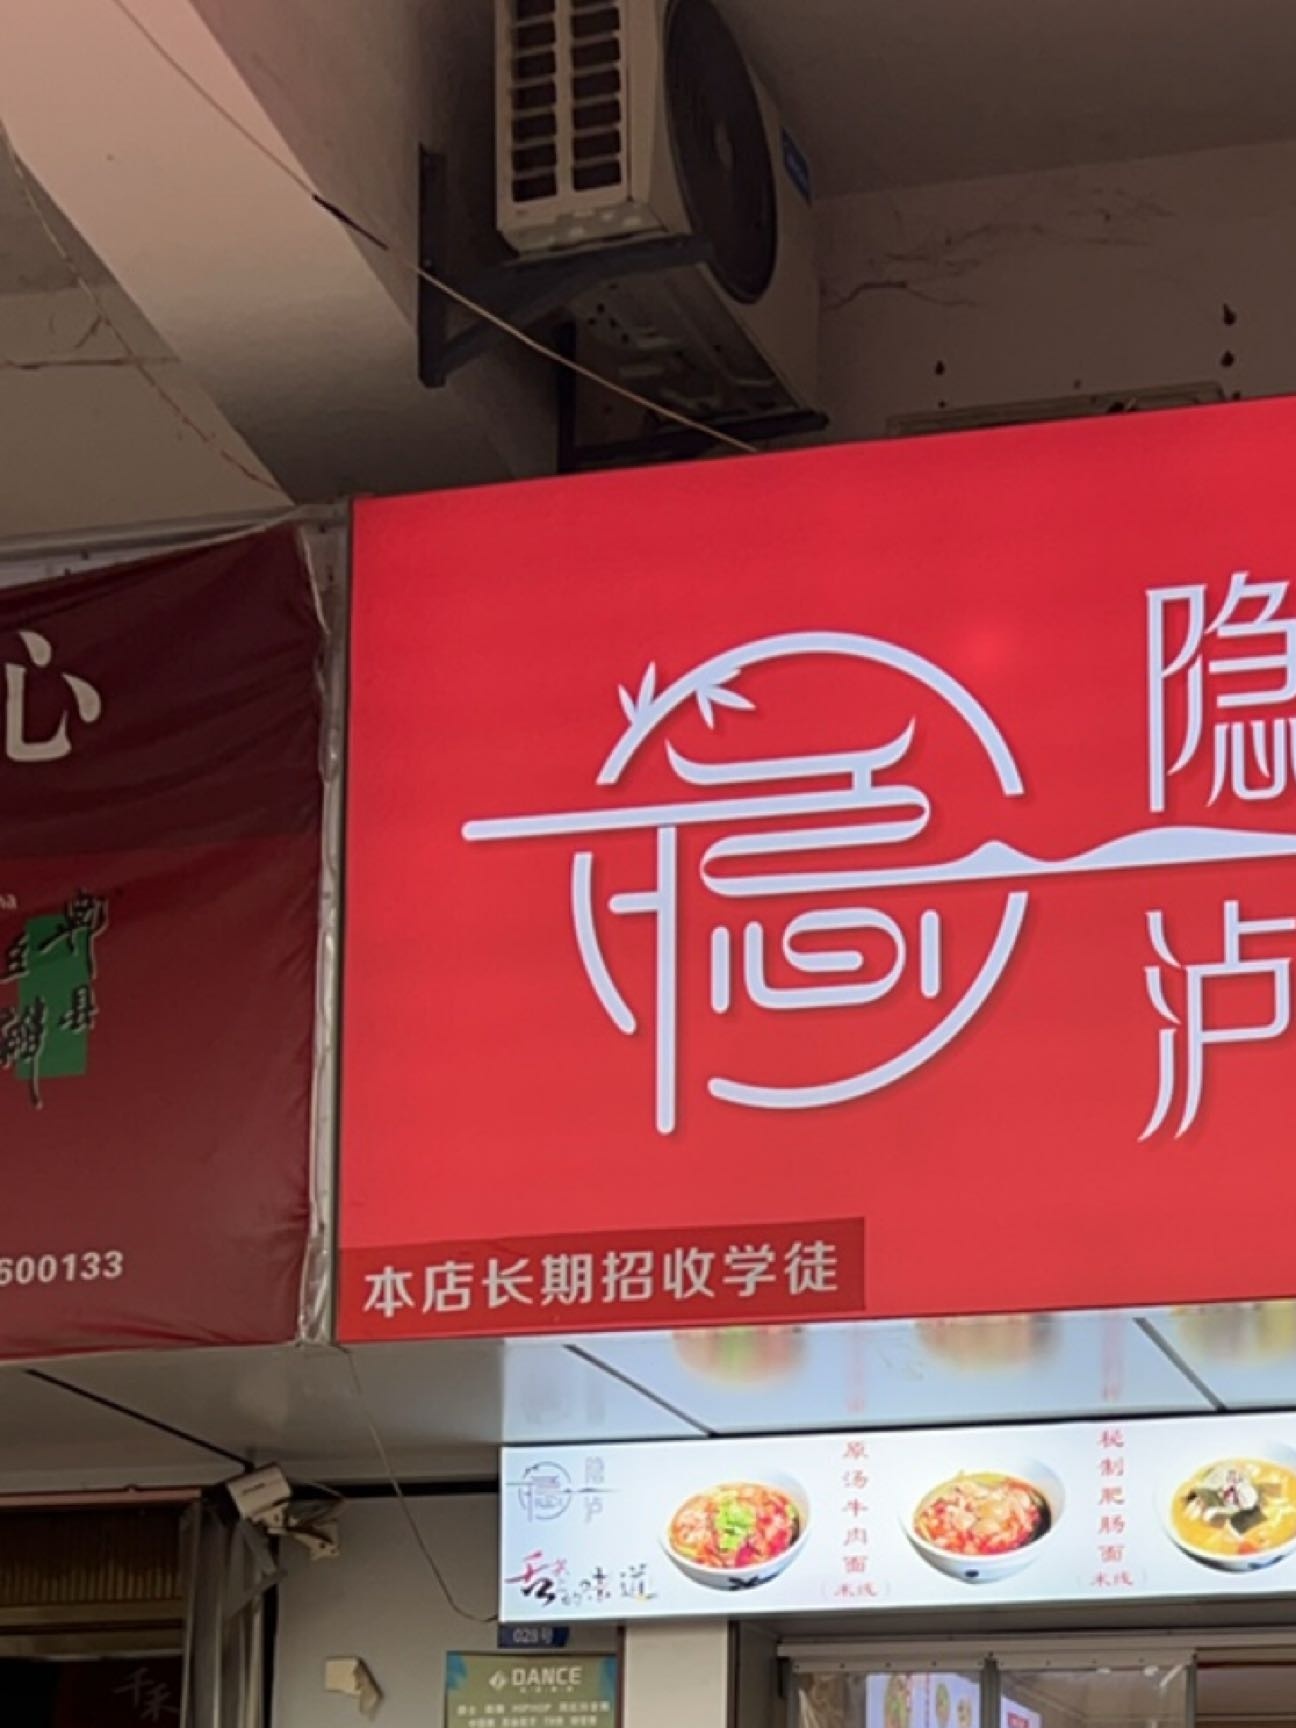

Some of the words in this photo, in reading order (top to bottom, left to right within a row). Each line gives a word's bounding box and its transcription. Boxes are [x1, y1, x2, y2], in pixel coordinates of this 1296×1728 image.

[4, 630, 102, 762] 心
[362, 1240, 839, 1318] 本店长期招收学徒
[842, 1440, 870, 1574] 原汤牛肉面
[511, 1666, 583, 1687] DANCE
